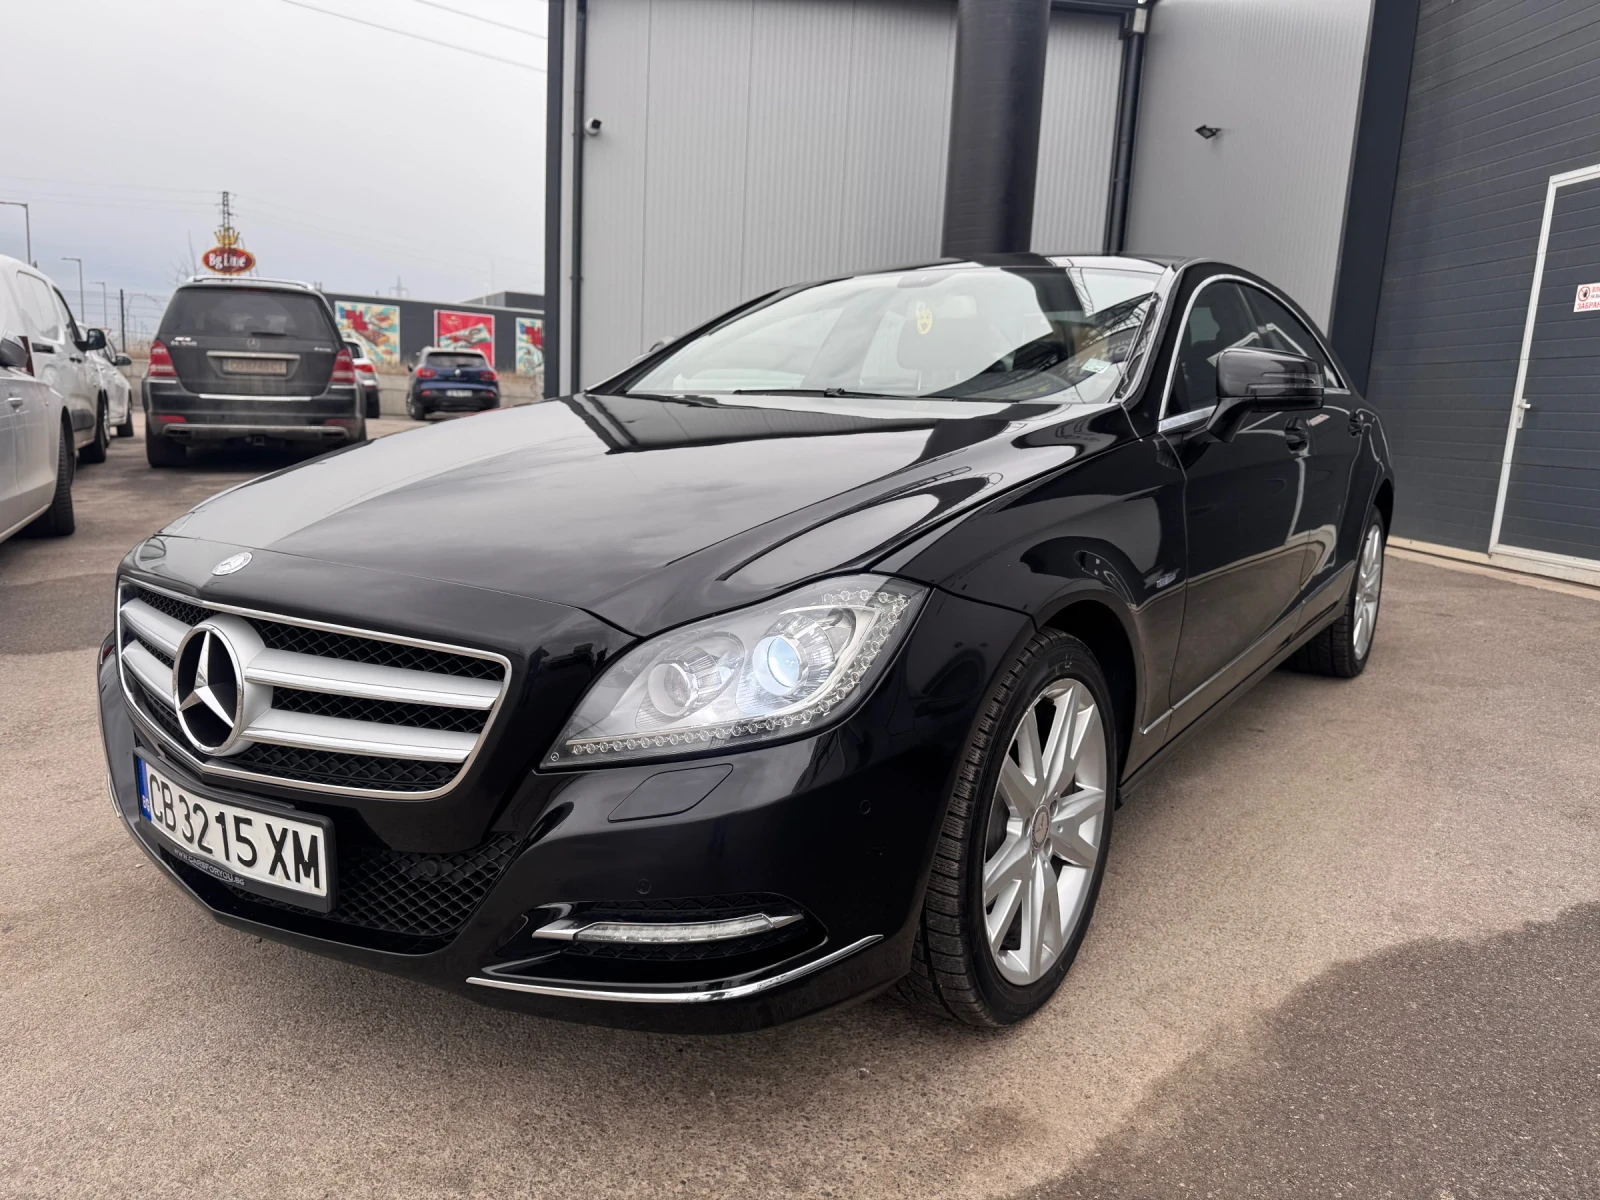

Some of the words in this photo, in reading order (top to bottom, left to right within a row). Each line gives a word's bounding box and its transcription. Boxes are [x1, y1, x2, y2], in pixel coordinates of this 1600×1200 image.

[142, 795, 150, 812] BG
[149, 773, 176, 833] CB
[178, 794, 258, 868] 3215
[265, 822, 321, 889] XM
